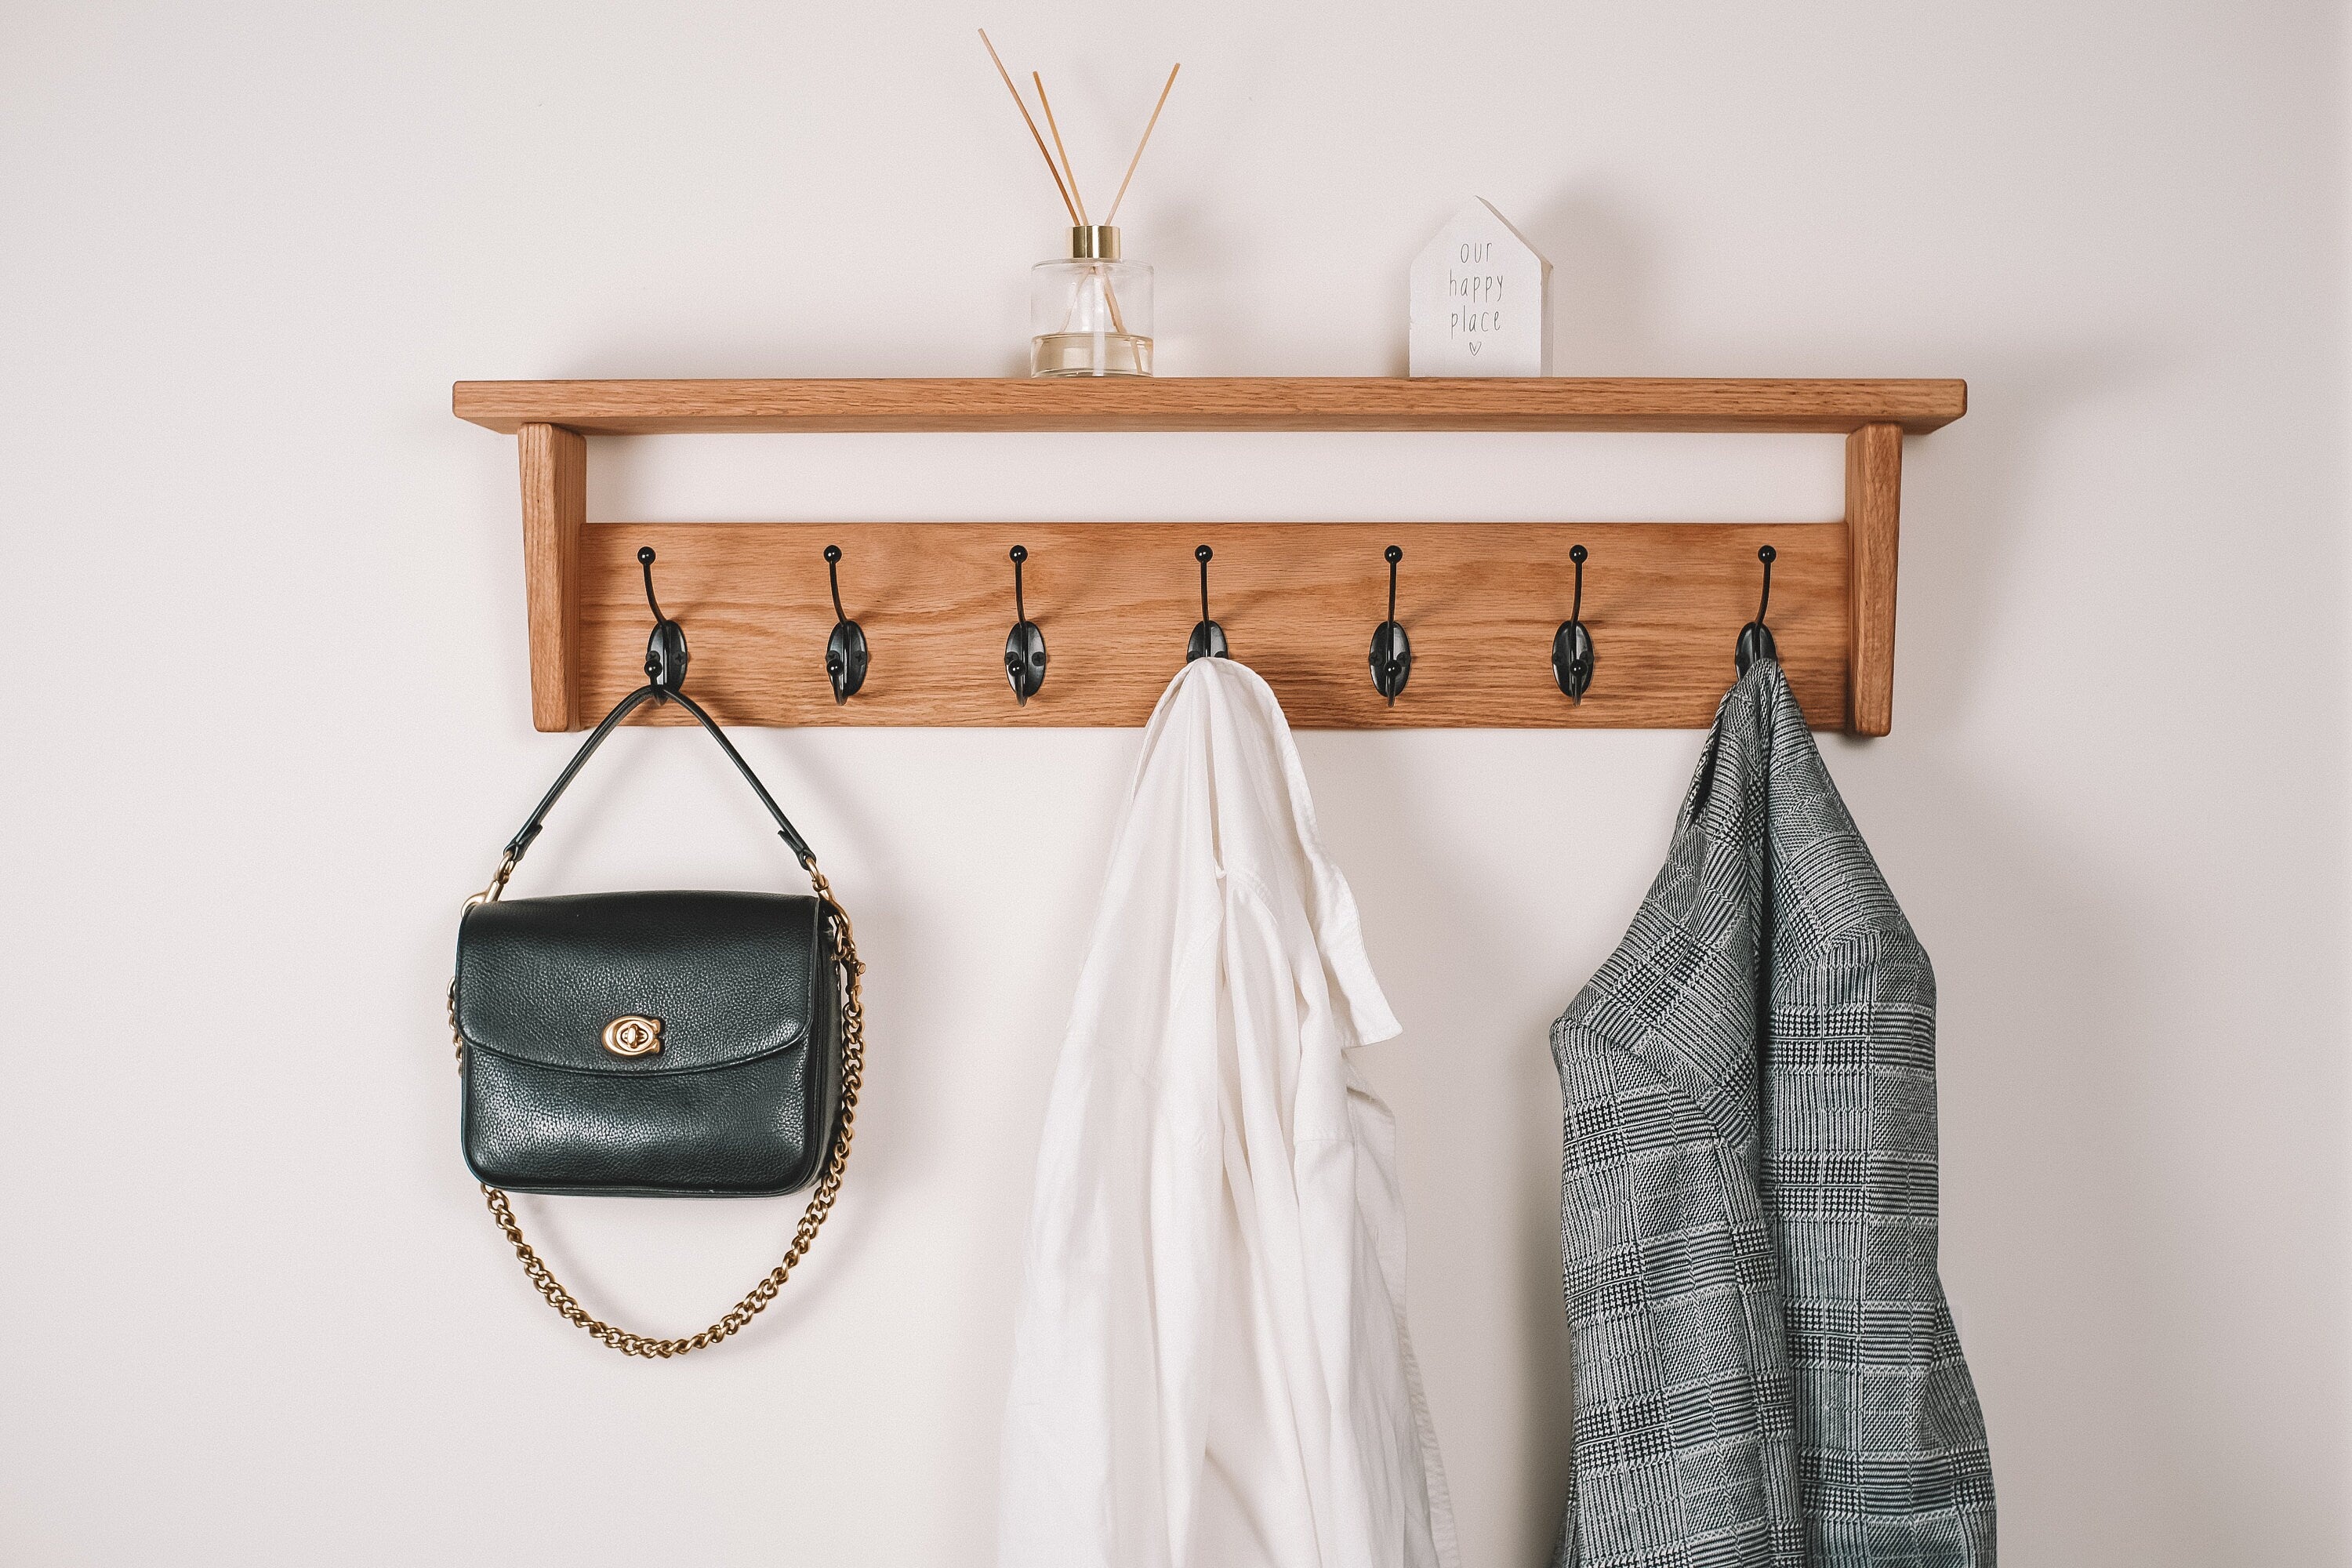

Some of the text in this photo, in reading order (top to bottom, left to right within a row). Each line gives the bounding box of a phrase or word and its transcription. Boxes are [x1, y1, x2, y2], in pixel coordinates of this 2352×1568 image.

[1460, 242, 1493, 263] our
[1449, 267, 1504, 303] happy
[1450, 305, 1501, 340] place
